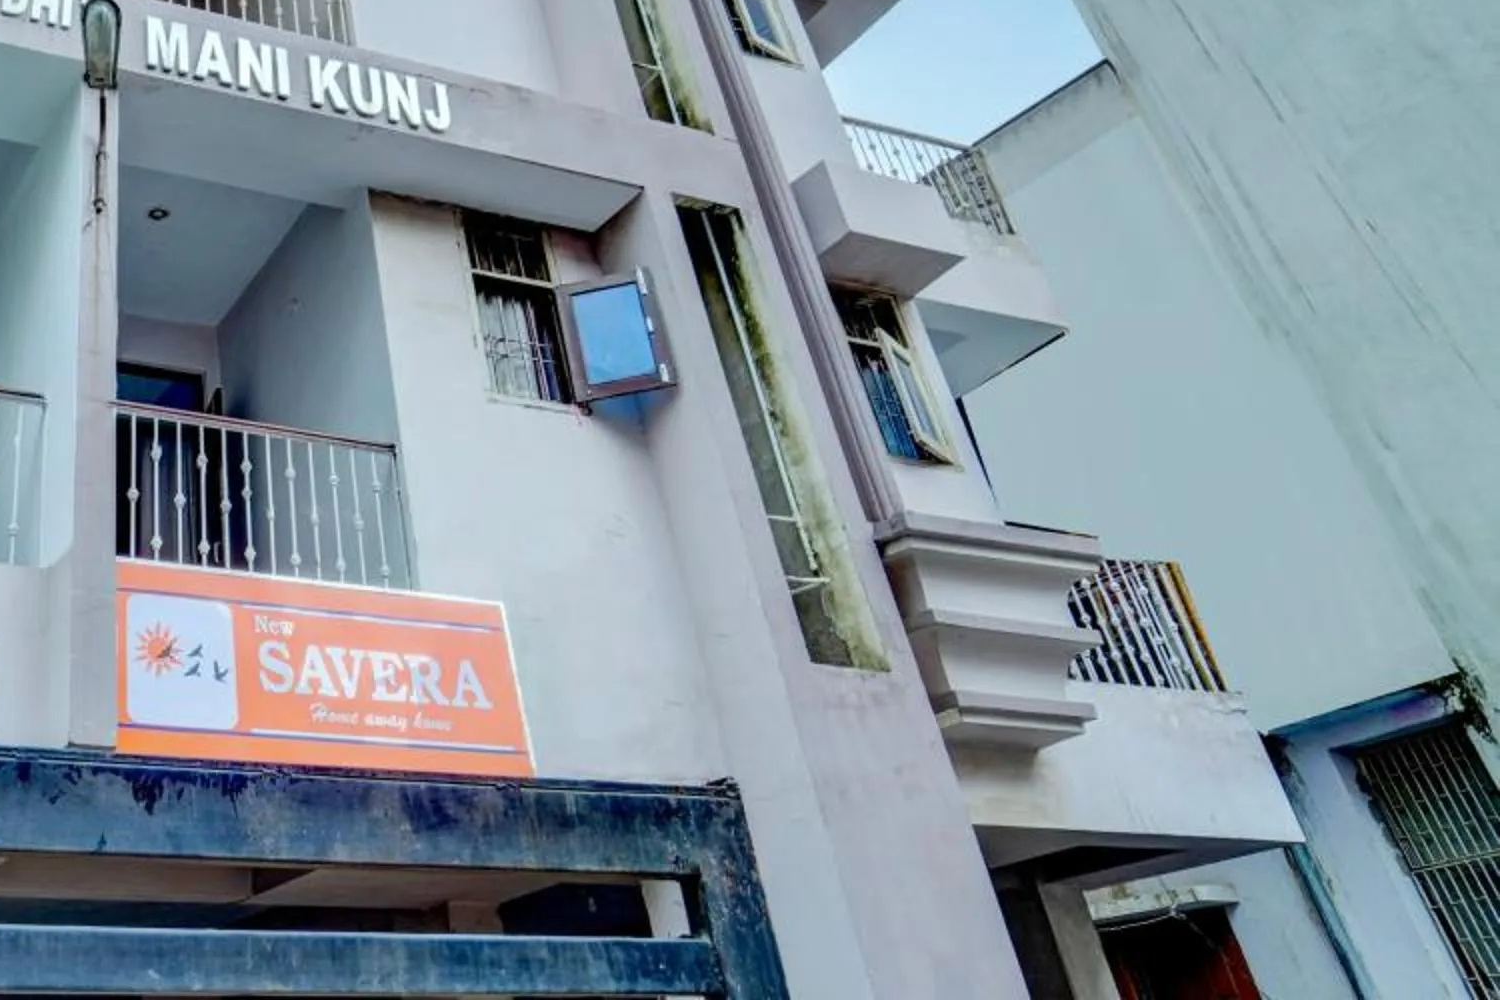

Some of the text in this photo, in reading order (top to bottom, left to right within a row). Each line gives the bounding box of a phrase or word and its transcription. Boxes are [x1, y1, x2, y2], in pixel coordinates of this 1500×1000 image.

[146, 15, 290, 99] MANI
[308, 53, 452, 133] KUNJ
[254, 614, 296, 637] New
[257, 640, 494, 710] SAVERA
